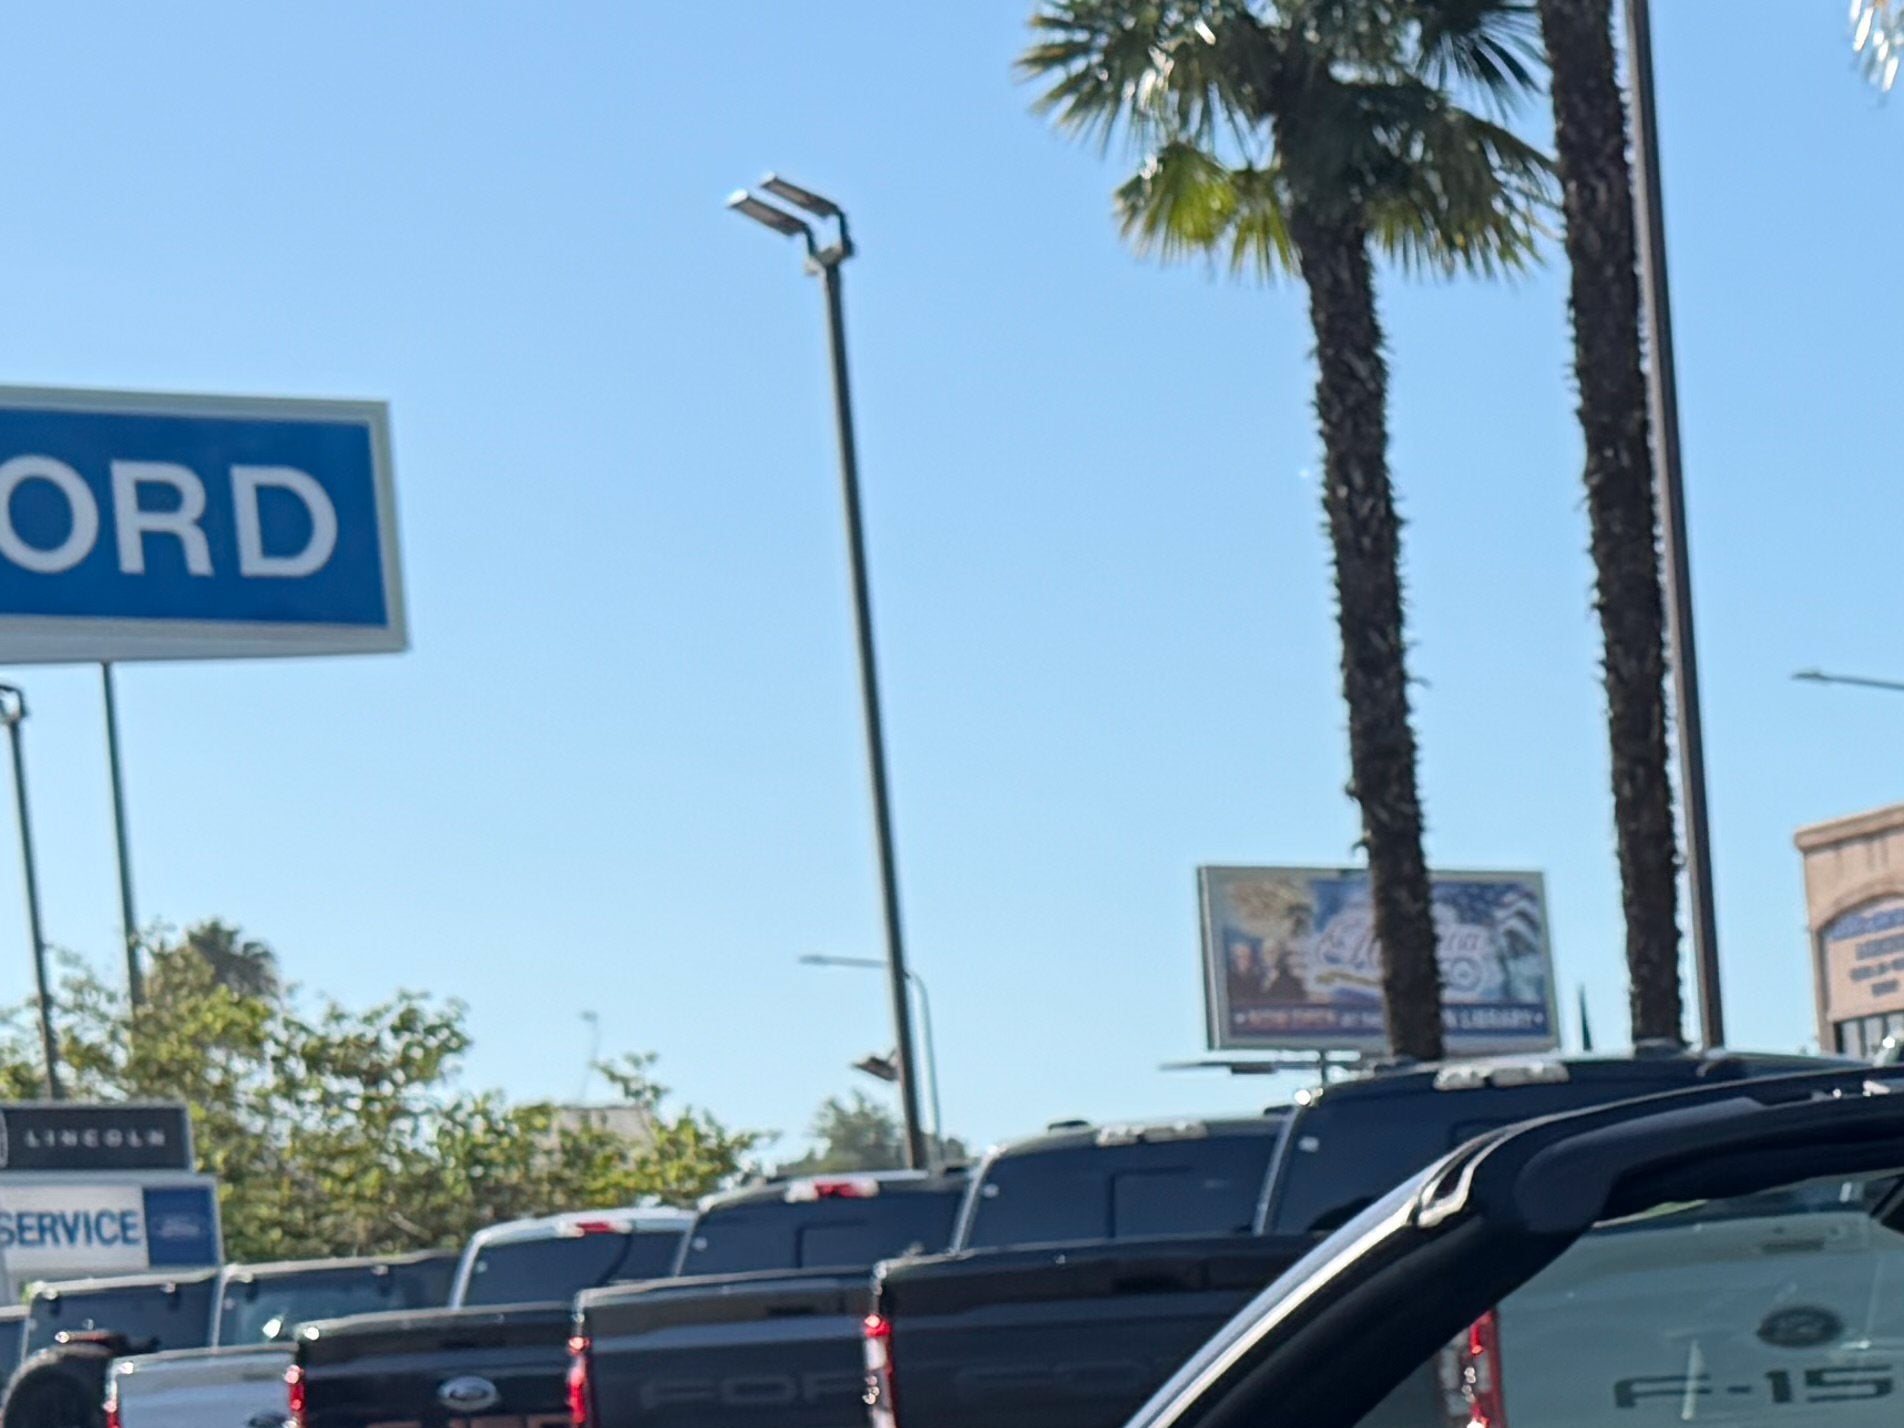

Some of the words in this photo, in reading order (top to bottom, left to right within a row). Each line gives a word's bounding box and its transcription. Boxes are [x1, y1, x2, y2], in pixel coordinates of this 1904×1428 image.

[0, 453, 338, 578] ORD
[24, 1129, 166, 1148] LINCOLN
[0, 1209, 141, 1248] SERVICE
